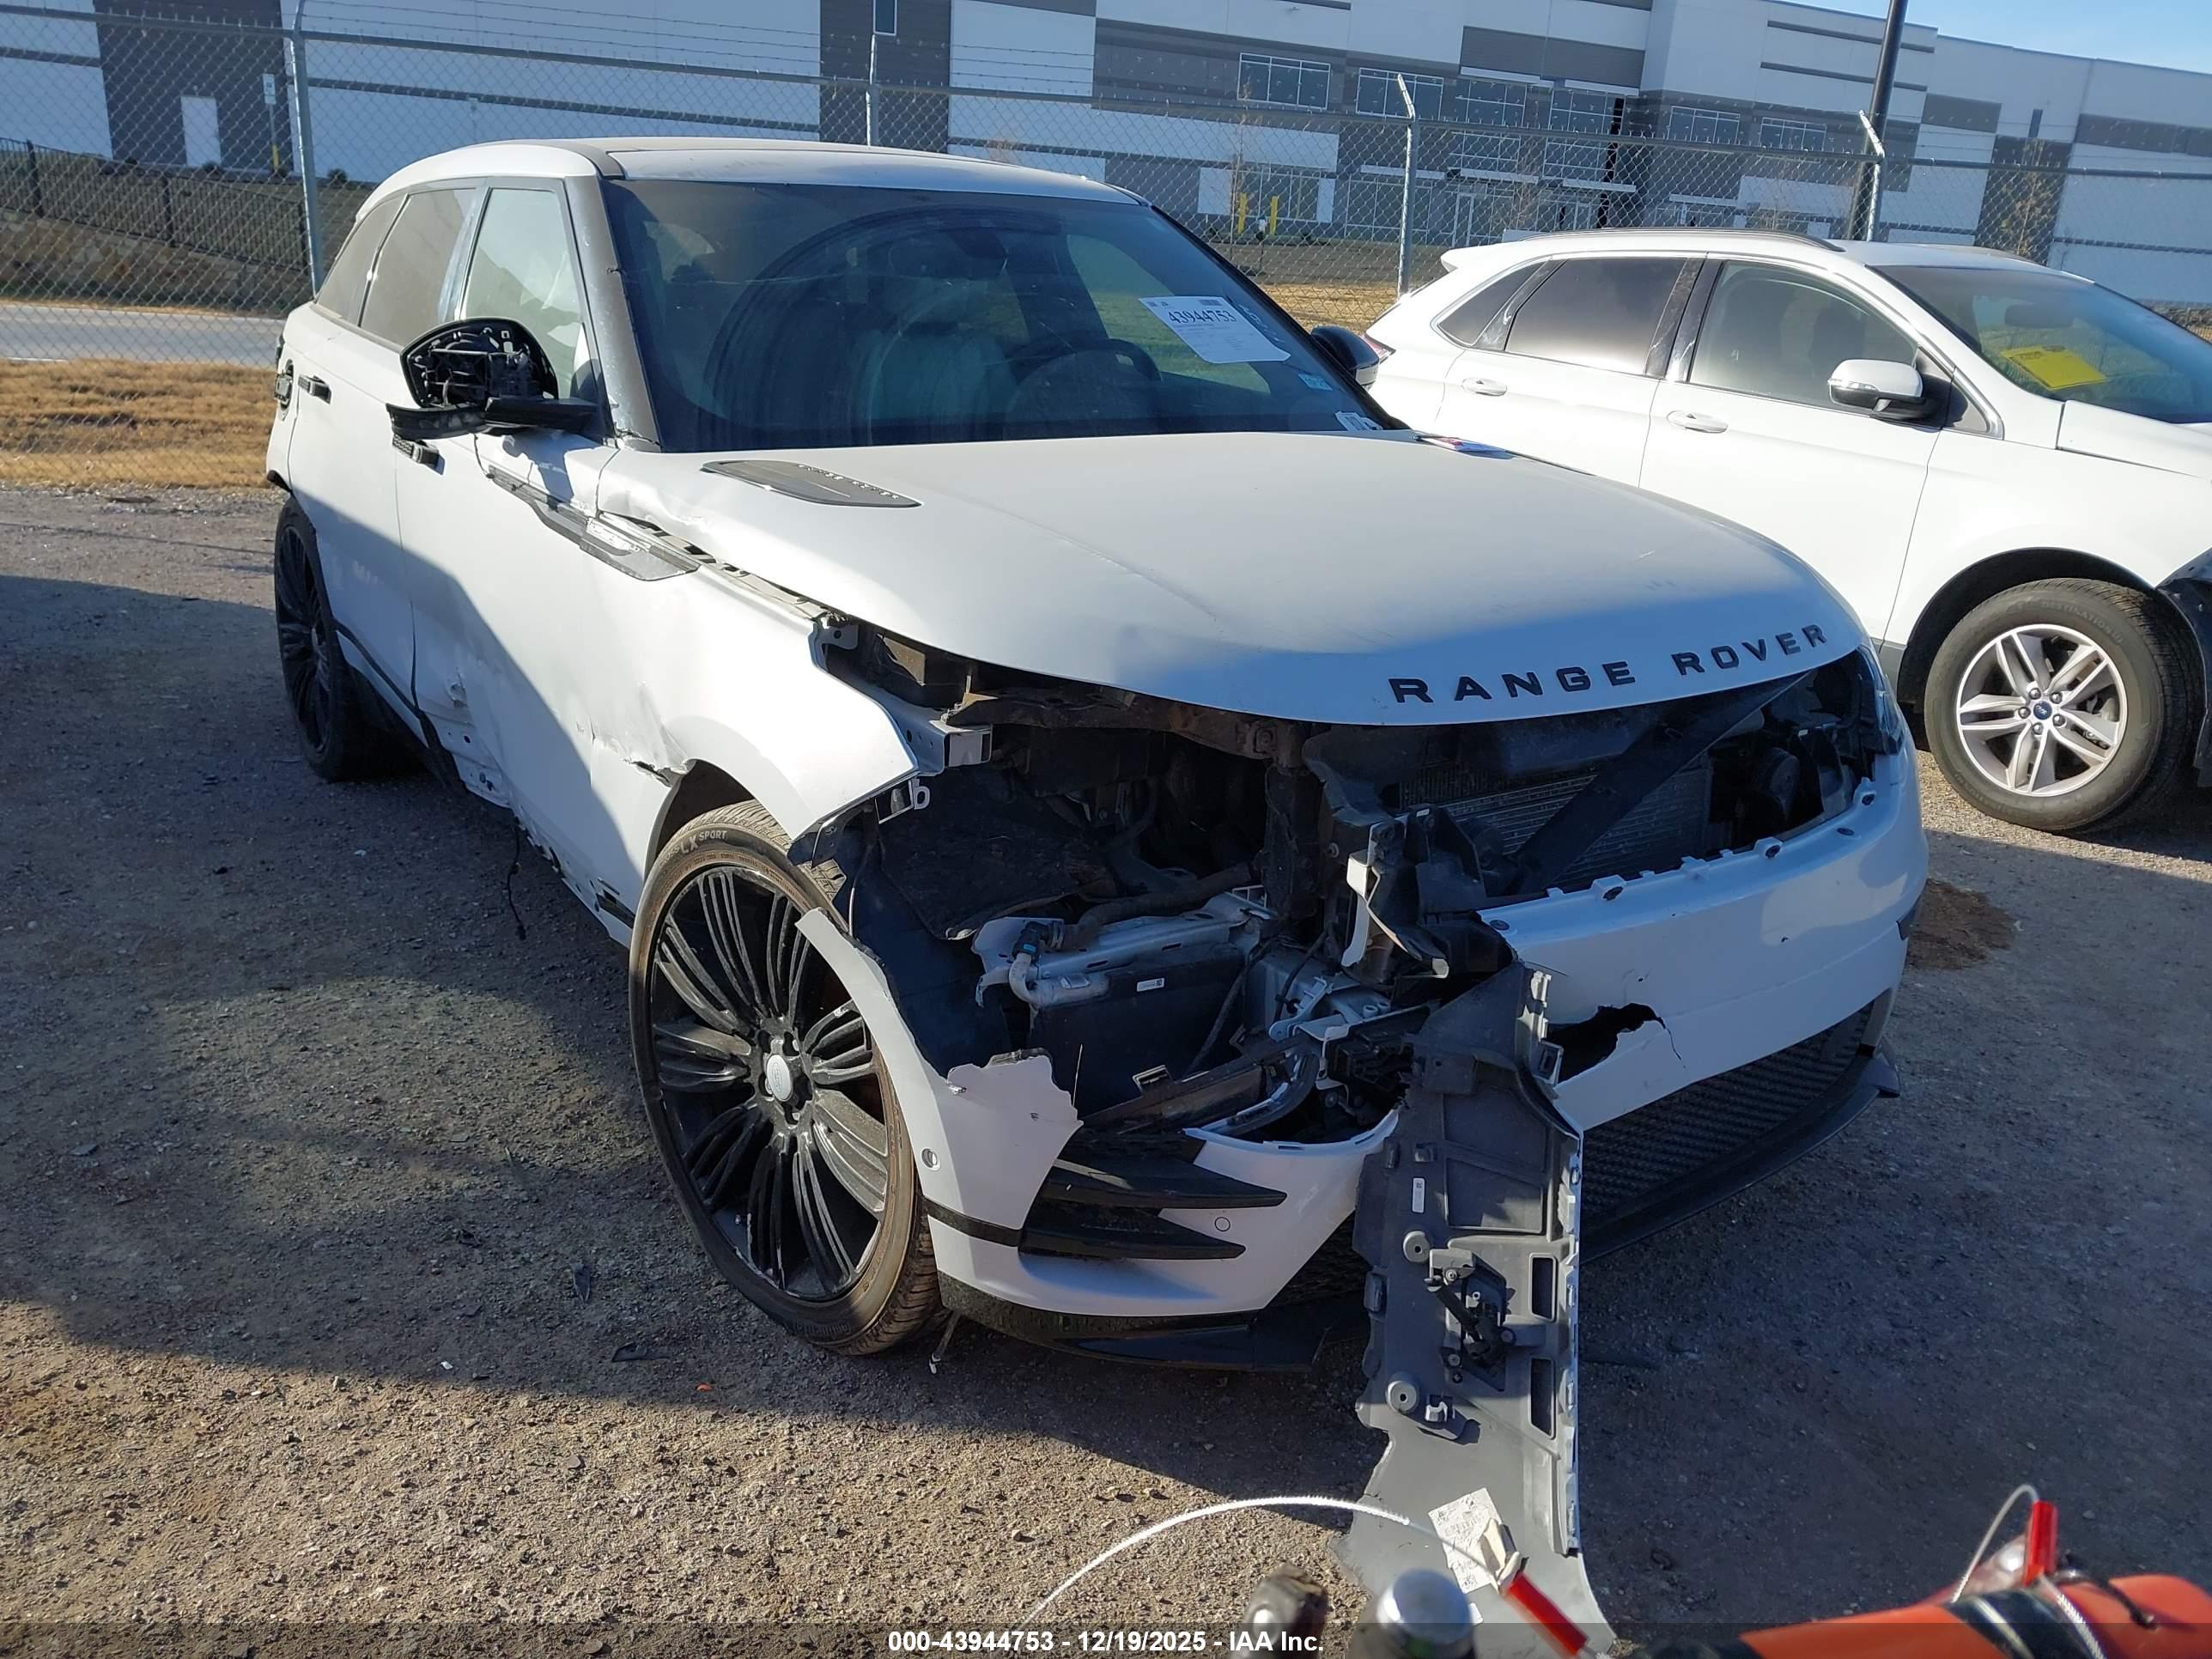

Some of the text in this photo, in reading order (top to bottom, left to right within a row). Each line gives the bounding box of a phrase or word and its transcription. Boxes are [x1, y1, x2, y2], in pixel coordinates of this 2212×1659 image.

[1168, 309, 1237, 324] 43944753
[1389, 624, 1827, 703] RANGE ROVER
[681, 834, 699, 854] LX
[698, 830, 728, 841] SPORT
